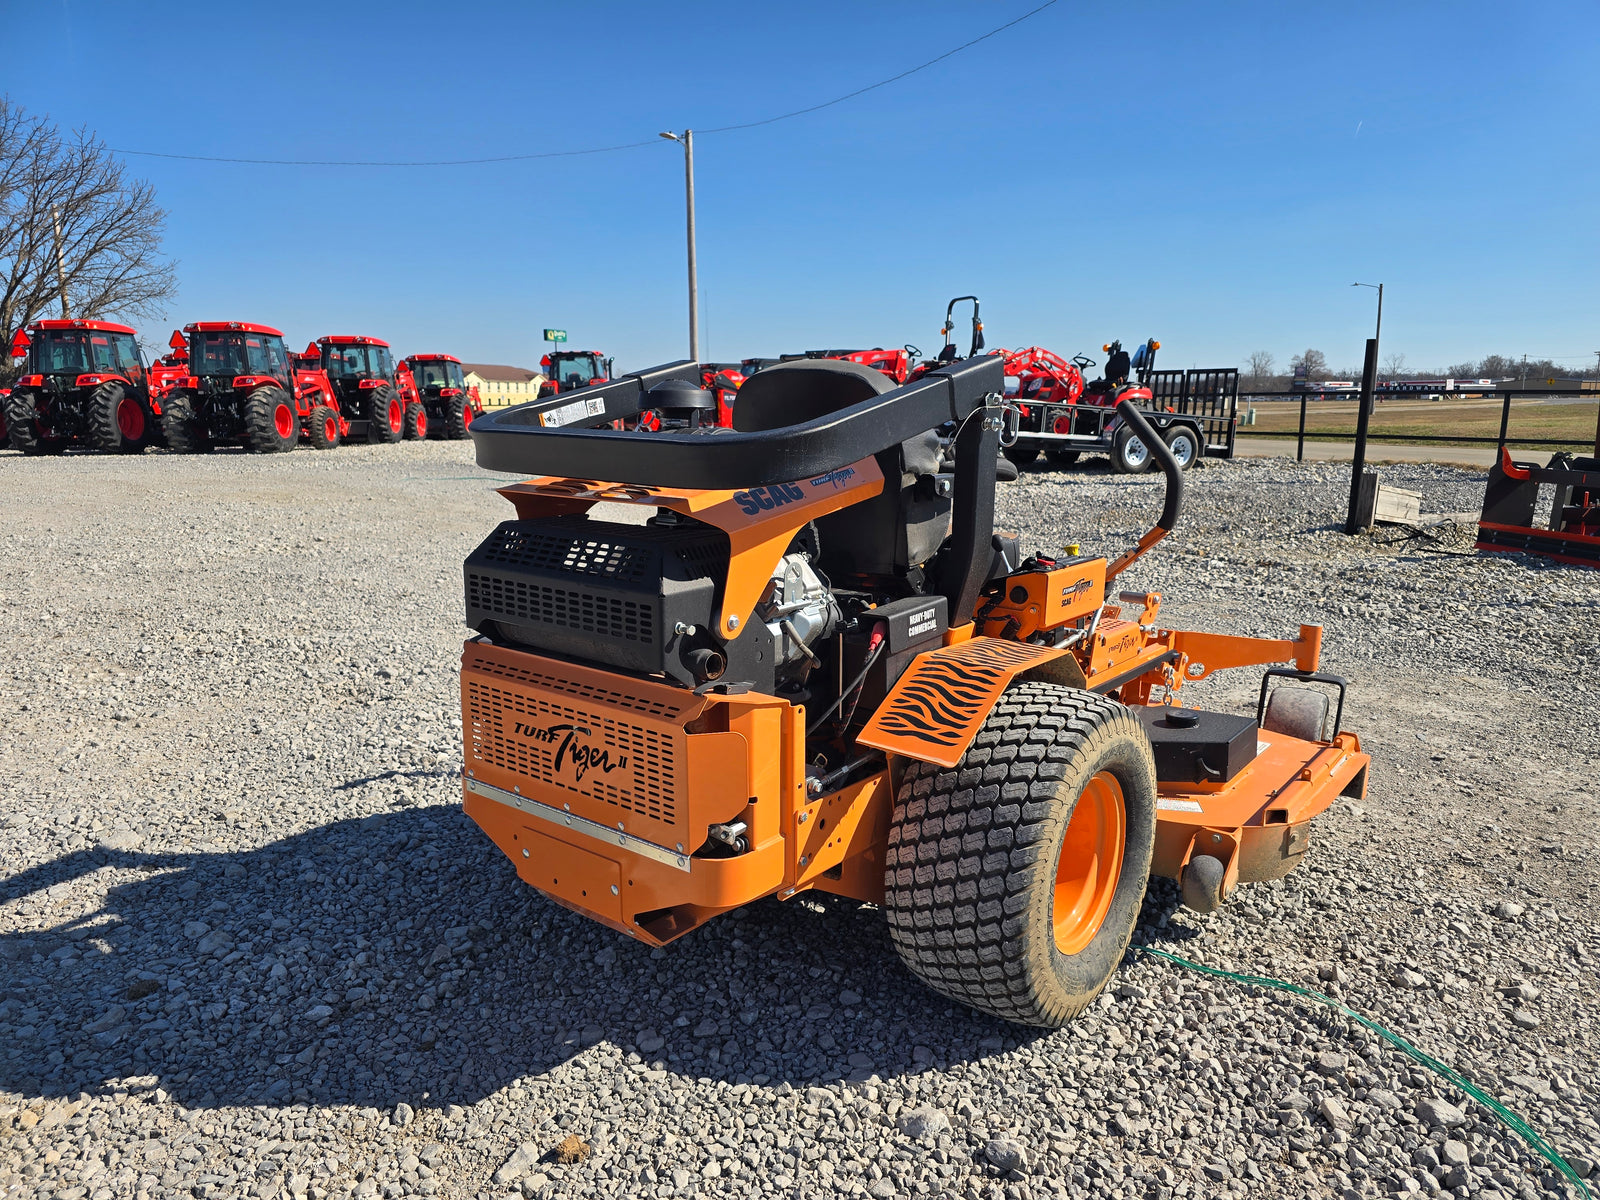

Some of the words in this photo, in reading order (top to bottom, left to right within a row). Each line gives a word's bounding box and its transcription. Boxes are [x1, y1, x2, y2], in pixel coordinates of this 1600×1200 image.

[733, 482, 804, 516] SCAG
[908, 619, 937, 637] COMMERCIAL
[909, 608, 936, 625] HEAVY-DUTY
[514, 722, 560, 744] TURF
[547, 723, 617, 782] Tiger
